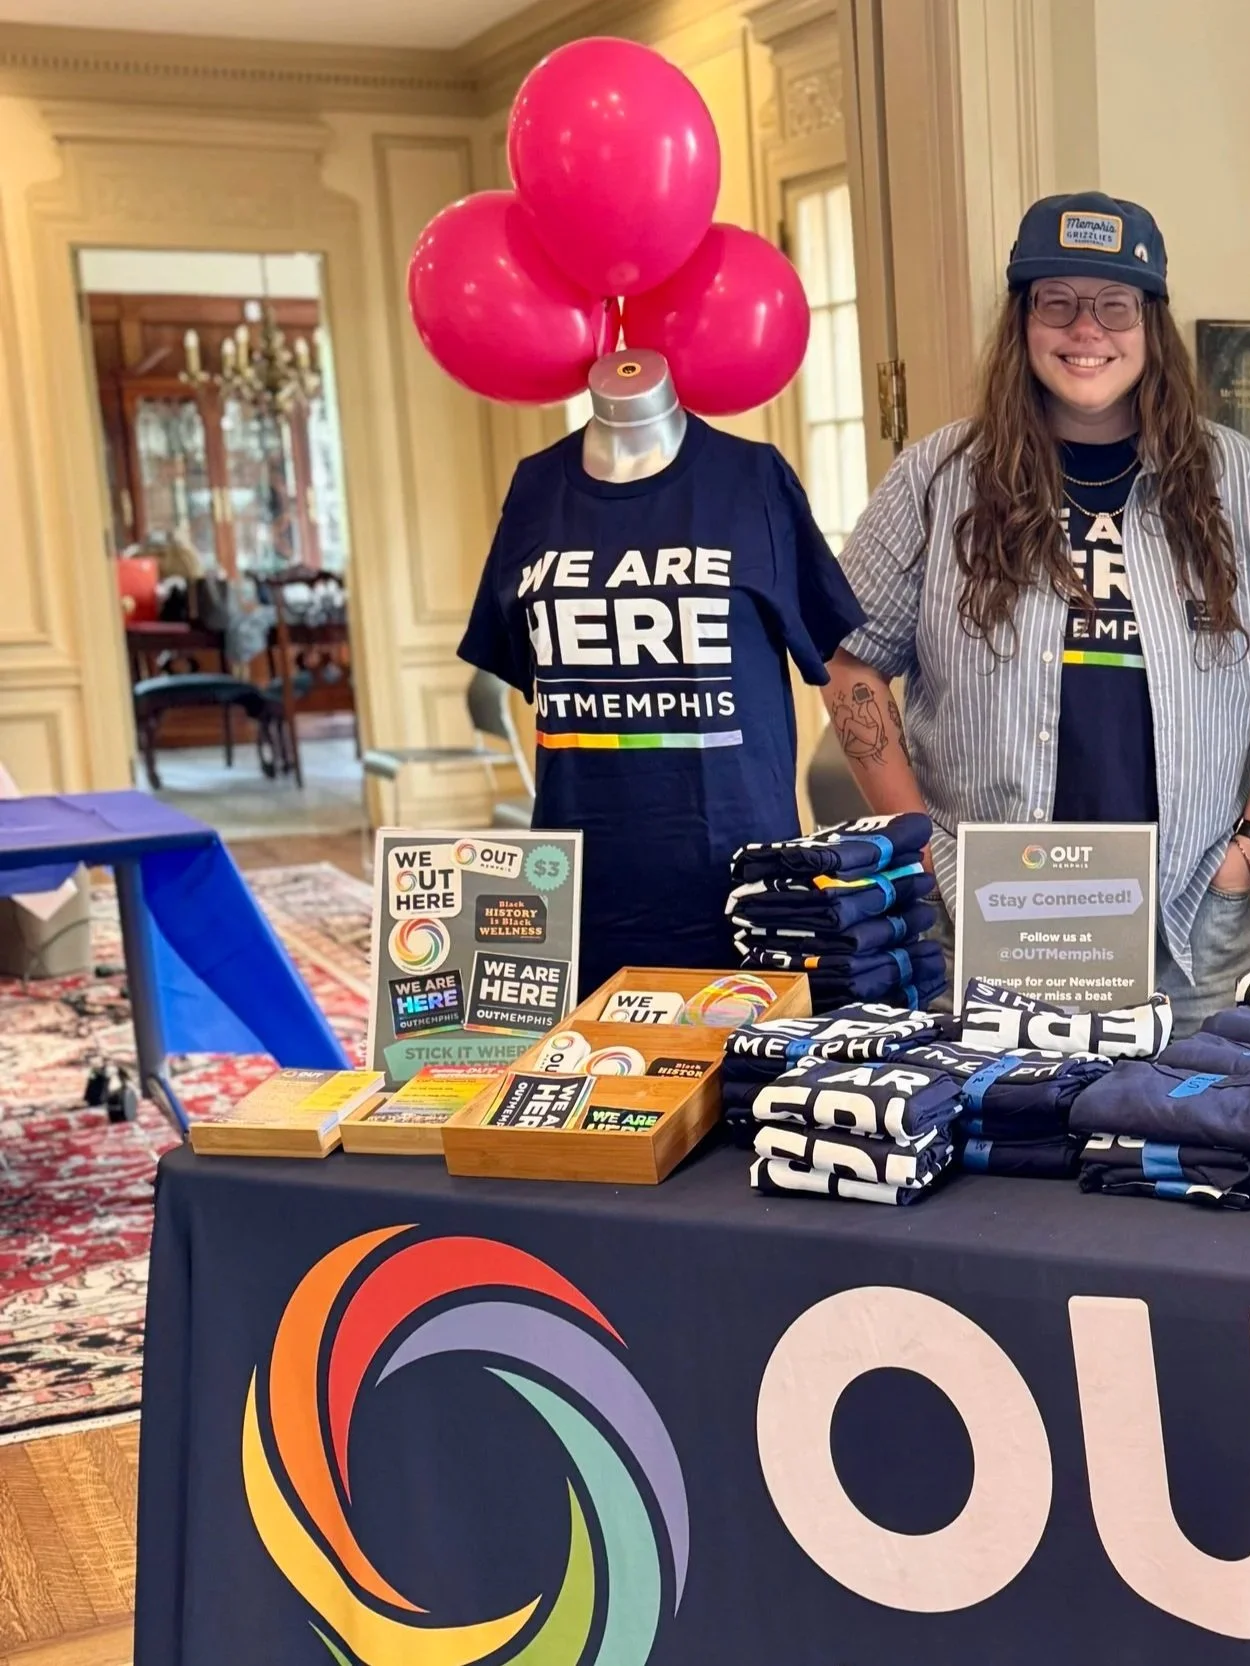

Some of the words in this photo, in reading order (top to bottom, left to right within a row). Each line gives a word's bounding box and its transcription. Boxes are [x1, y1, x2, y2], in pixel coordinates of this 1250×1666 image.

[1066, 218, 1116, 233] Memphis
[1067, 231, 1112, 242] GRIZZLIES
[517, 550, 594, 598] WE
[605, 546, 732, 588] ARE
[526, 597, 732, 667] HERE
[537, 691, 735, 719] UTMEMPHIS
[394, 851, 432, 869] WE
[480, 848, 518, 867] OUT
[1050, 846, 1094, 862] OUT
[533, 858, 560, 878] $3
[396, 893, 455, 910] HERE
[499, 900, 525, 908] Black
[988, 893, 1028, 910] Stay
[1032, 889, 1132, 906] Connected!
[485, 908, 538, 918] HISTORY
[502, 918, 531, 926] Black
[479, 926, 542, 936] WELLNESS
[1020, 932, 1060, 943] Follow
[1063, 933, 1077, 943] us
[1079, 932, 1092, 942] at
[1000, 947, 1115, 963] @OUTMemphis
[484, 960, 516, 978] WE
[520, 964, 561, 983] ARE
[395, 980, 421, 995] WE
[425, 975, 456, 992] ARE
[1025, 975, 1044, 987] for
[1046, 977, 1066, 987] our
[1069, 976, 1135, 988] Newsletter
[479, 978, 559, 1008] HERE
[618, 994, 653, 1008] WE
[1045, 990, 1073, 1000] miss
[1074, 991, 1084, 1000] a
[1085, 989, 1113, 1000] beat
[396, 989, 458, 1015] HERE
[400, 1012, 460, 1029] OUTMEMPHIS
[476, 1009, 553, 1026] OUTMEMPHIS
[405, 1047, 456, 1061] STICK
[458, 1046, 473, 1058] IT
[657, 1067, 703, 1078] HISTOR
[675, 1062, 702, 1070] Black
[593, 1110, 621, 1124] WE
[622, 1112, 658, 1127] ARE
